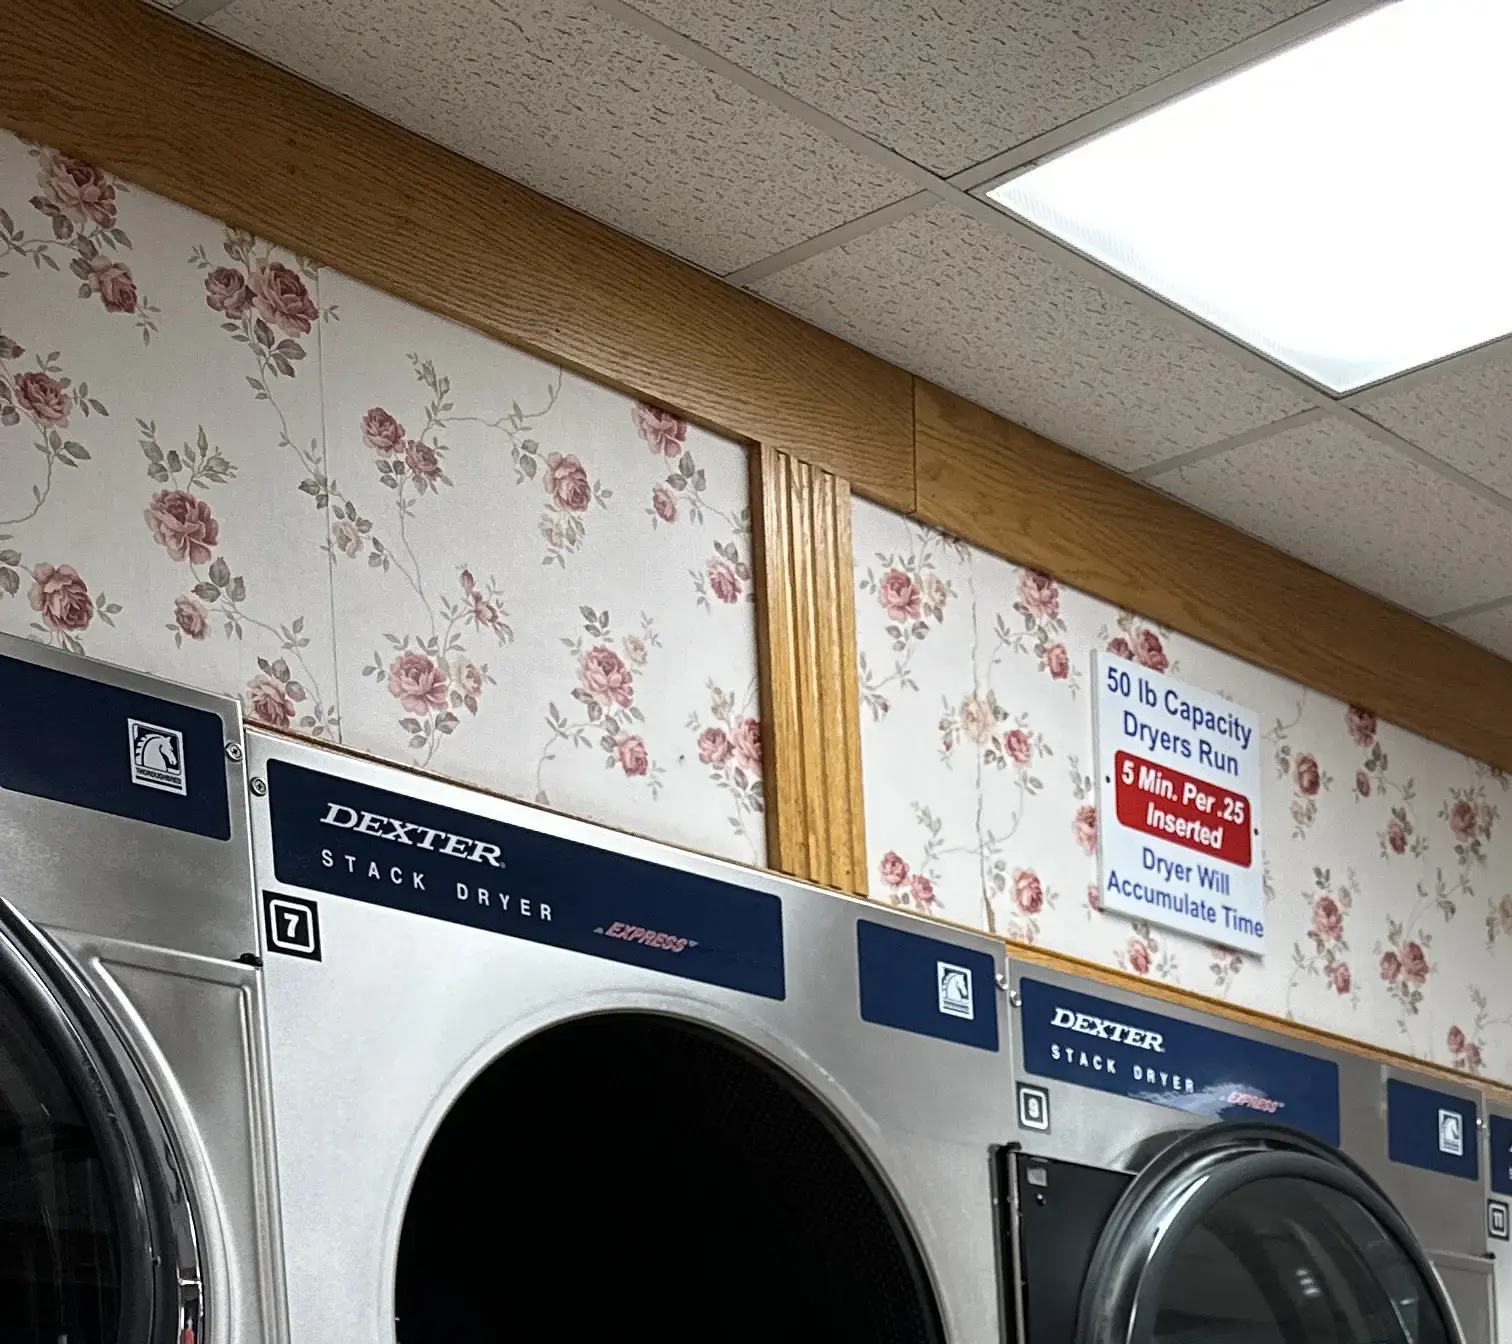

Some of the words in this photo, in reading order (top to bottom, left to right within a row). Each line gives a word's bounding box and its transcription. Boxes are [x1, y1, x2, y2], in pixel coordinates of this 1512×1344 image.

[1107, 666, 1131, 697] 50
[1138, 678, 1157, 707] lb
[1165, 690, 1252, 750] Capacity
[1123, 710, 1191, 759] Dryers
[1199, 739, 1239, 776] Run
[1121, 760, 1135, 785] 5
[1138, 766, 1178, 801] Min.
[1182, 781, 1216, 814] Per
[1217, 796, 1245, 825] .25
[320, 802, 503, 868] DEXTER
[1147, 802, 1224, 850] Inserted
[321, 849, 426, 890] STACK
[456, 882, 552, 921] DRYER
[1143, 847, 1192, 882] Dryer
[1197, 864, 1231, 896] Will
[283, 912, 299, 938] 7
[1107, 870, 1216, 923] Accumulate
[1222, 905, 1265, 938] Time
[605, 921, 688, 952] EXPRESS
[1050, 1006, 1165, 1052] DEXTER
[1051, 1044, 1116, 1075] STACK
[1133, 1065, 1195, 1093] DRYER
